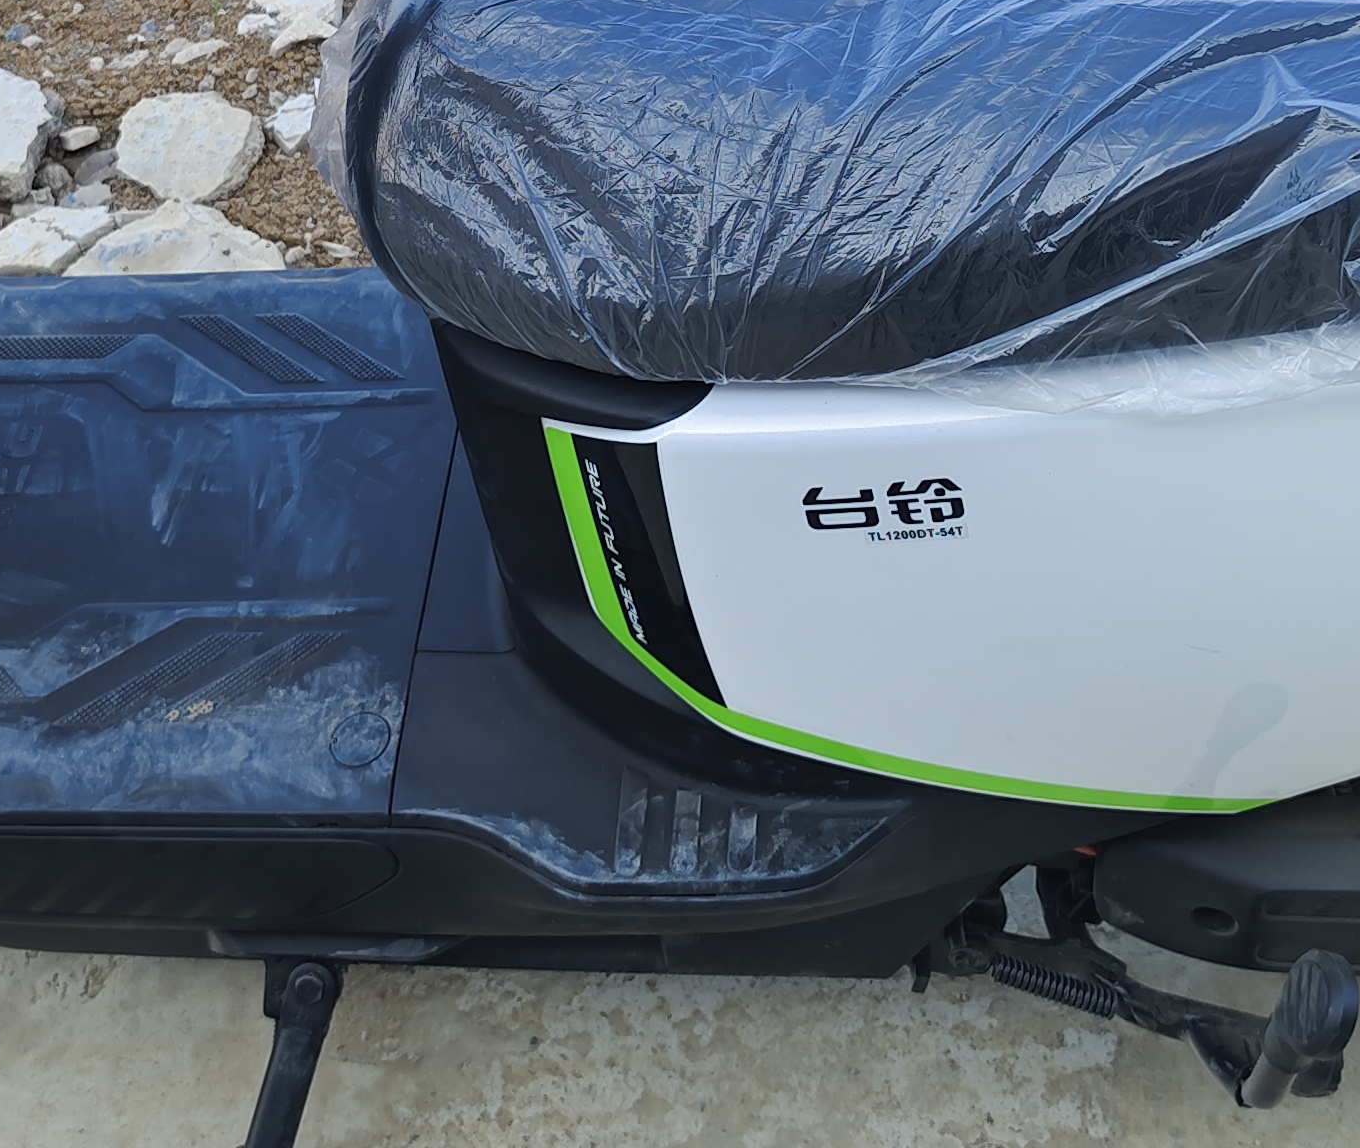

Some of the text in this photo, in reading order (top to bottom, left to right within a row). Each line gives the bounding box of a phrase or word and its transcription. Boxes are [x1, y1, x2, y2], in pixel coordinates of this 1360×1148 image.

[802, 478, 965, 530] 台铃
[584, 458, 649, 645] MADE IN FUTURE
[867, 525, 964, 542] TL1200DT-54T
